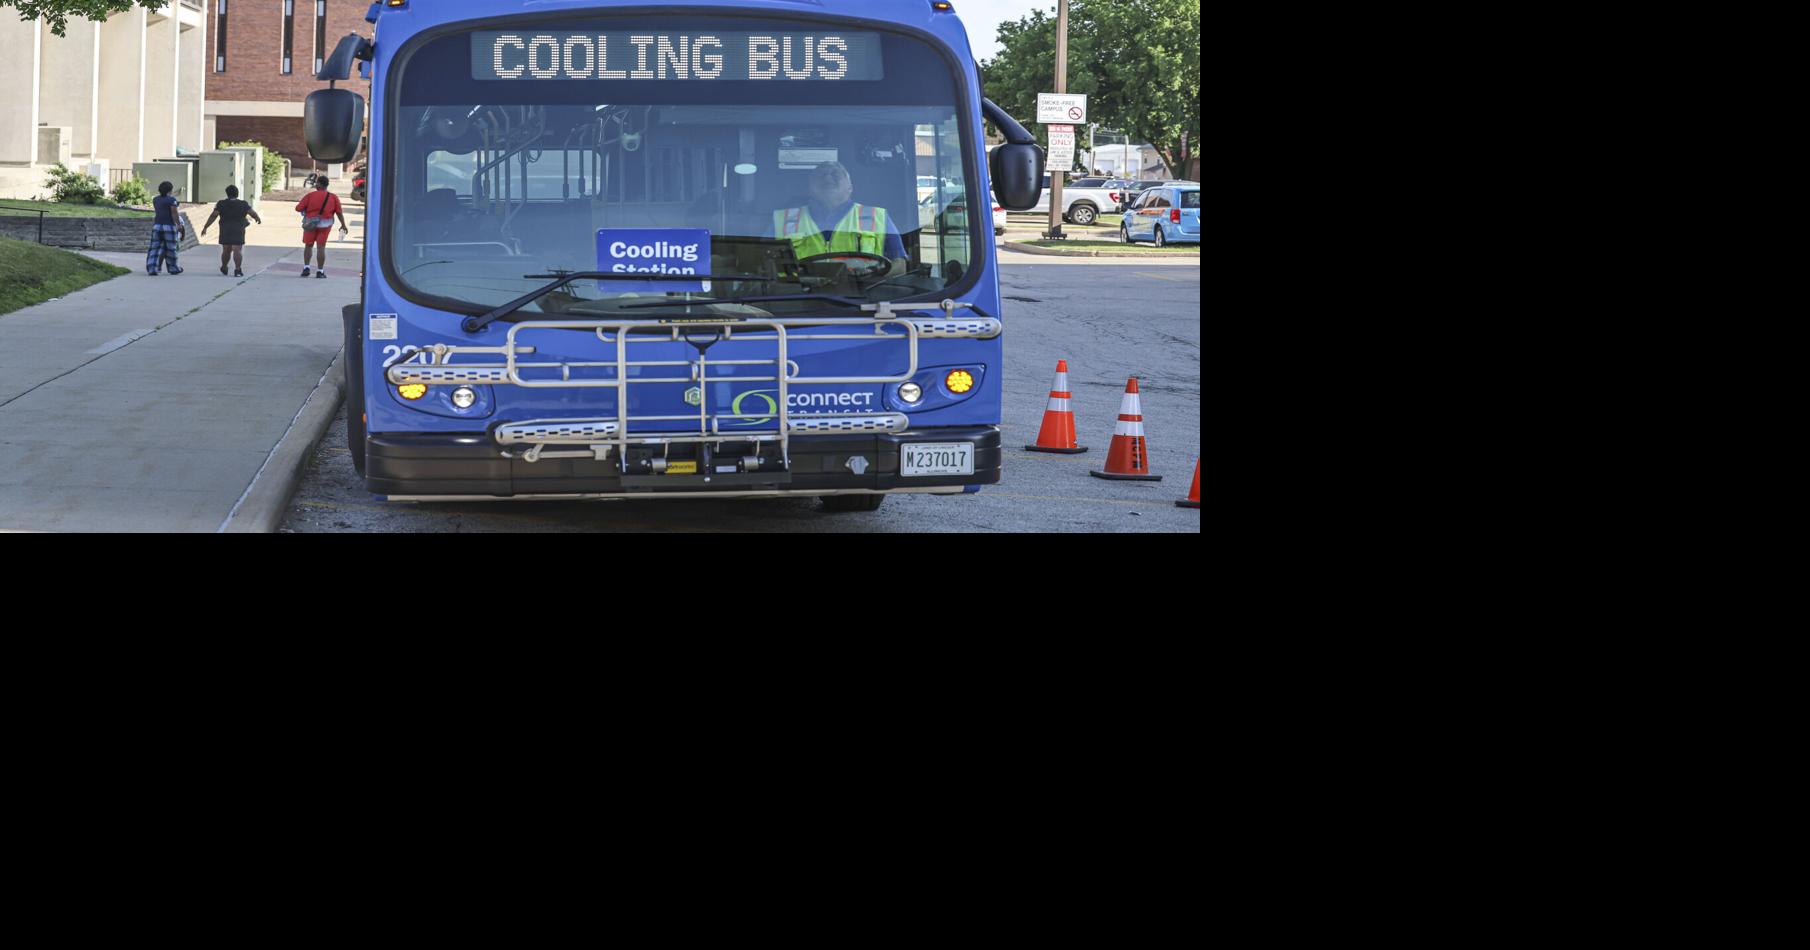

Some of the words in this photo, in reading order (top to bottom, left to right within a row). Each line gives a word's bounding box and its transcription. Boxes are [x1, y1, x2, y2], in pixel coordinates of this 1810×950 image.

[493, 35, 723, 79] COOLING
[748, 36, 848, 80] BUS
[1051, 138, 1072, 146] ONLY
[609, 241, 699, 262] Cooling
